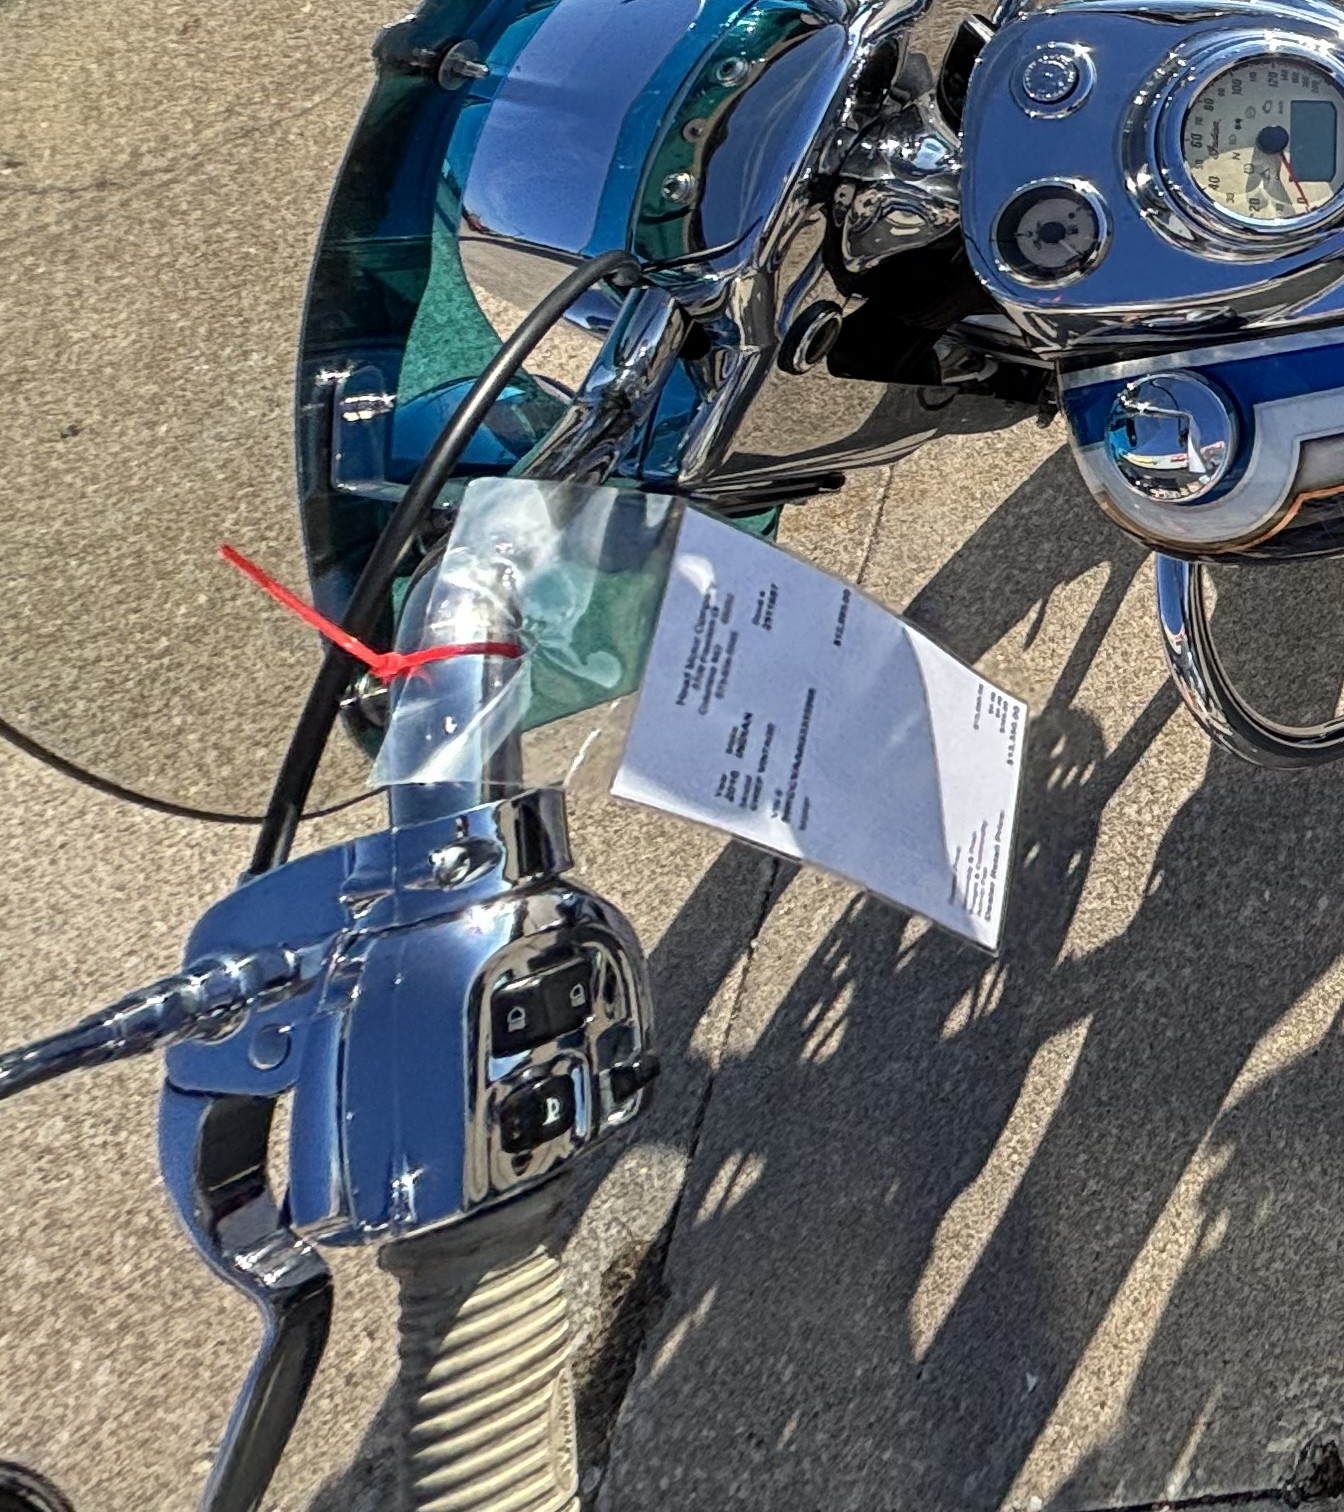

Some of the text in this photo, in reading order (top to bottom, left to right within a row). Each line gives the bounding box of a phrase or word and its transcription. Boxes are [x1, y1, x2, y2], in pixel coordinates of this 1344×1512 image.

[1230, 78, 1243, 96] 100
[1267, 71, 1279, 88] 120
[1203, 97, 1215, 112] 80
[1190, 132, 1204, 149] 60
[1208, 175, 1221, 191] 40
[1225, 192, 1235, 204] 30
[1248, 197, 1261, 212] 20
[735, 711, 753, 759] INDIAN
